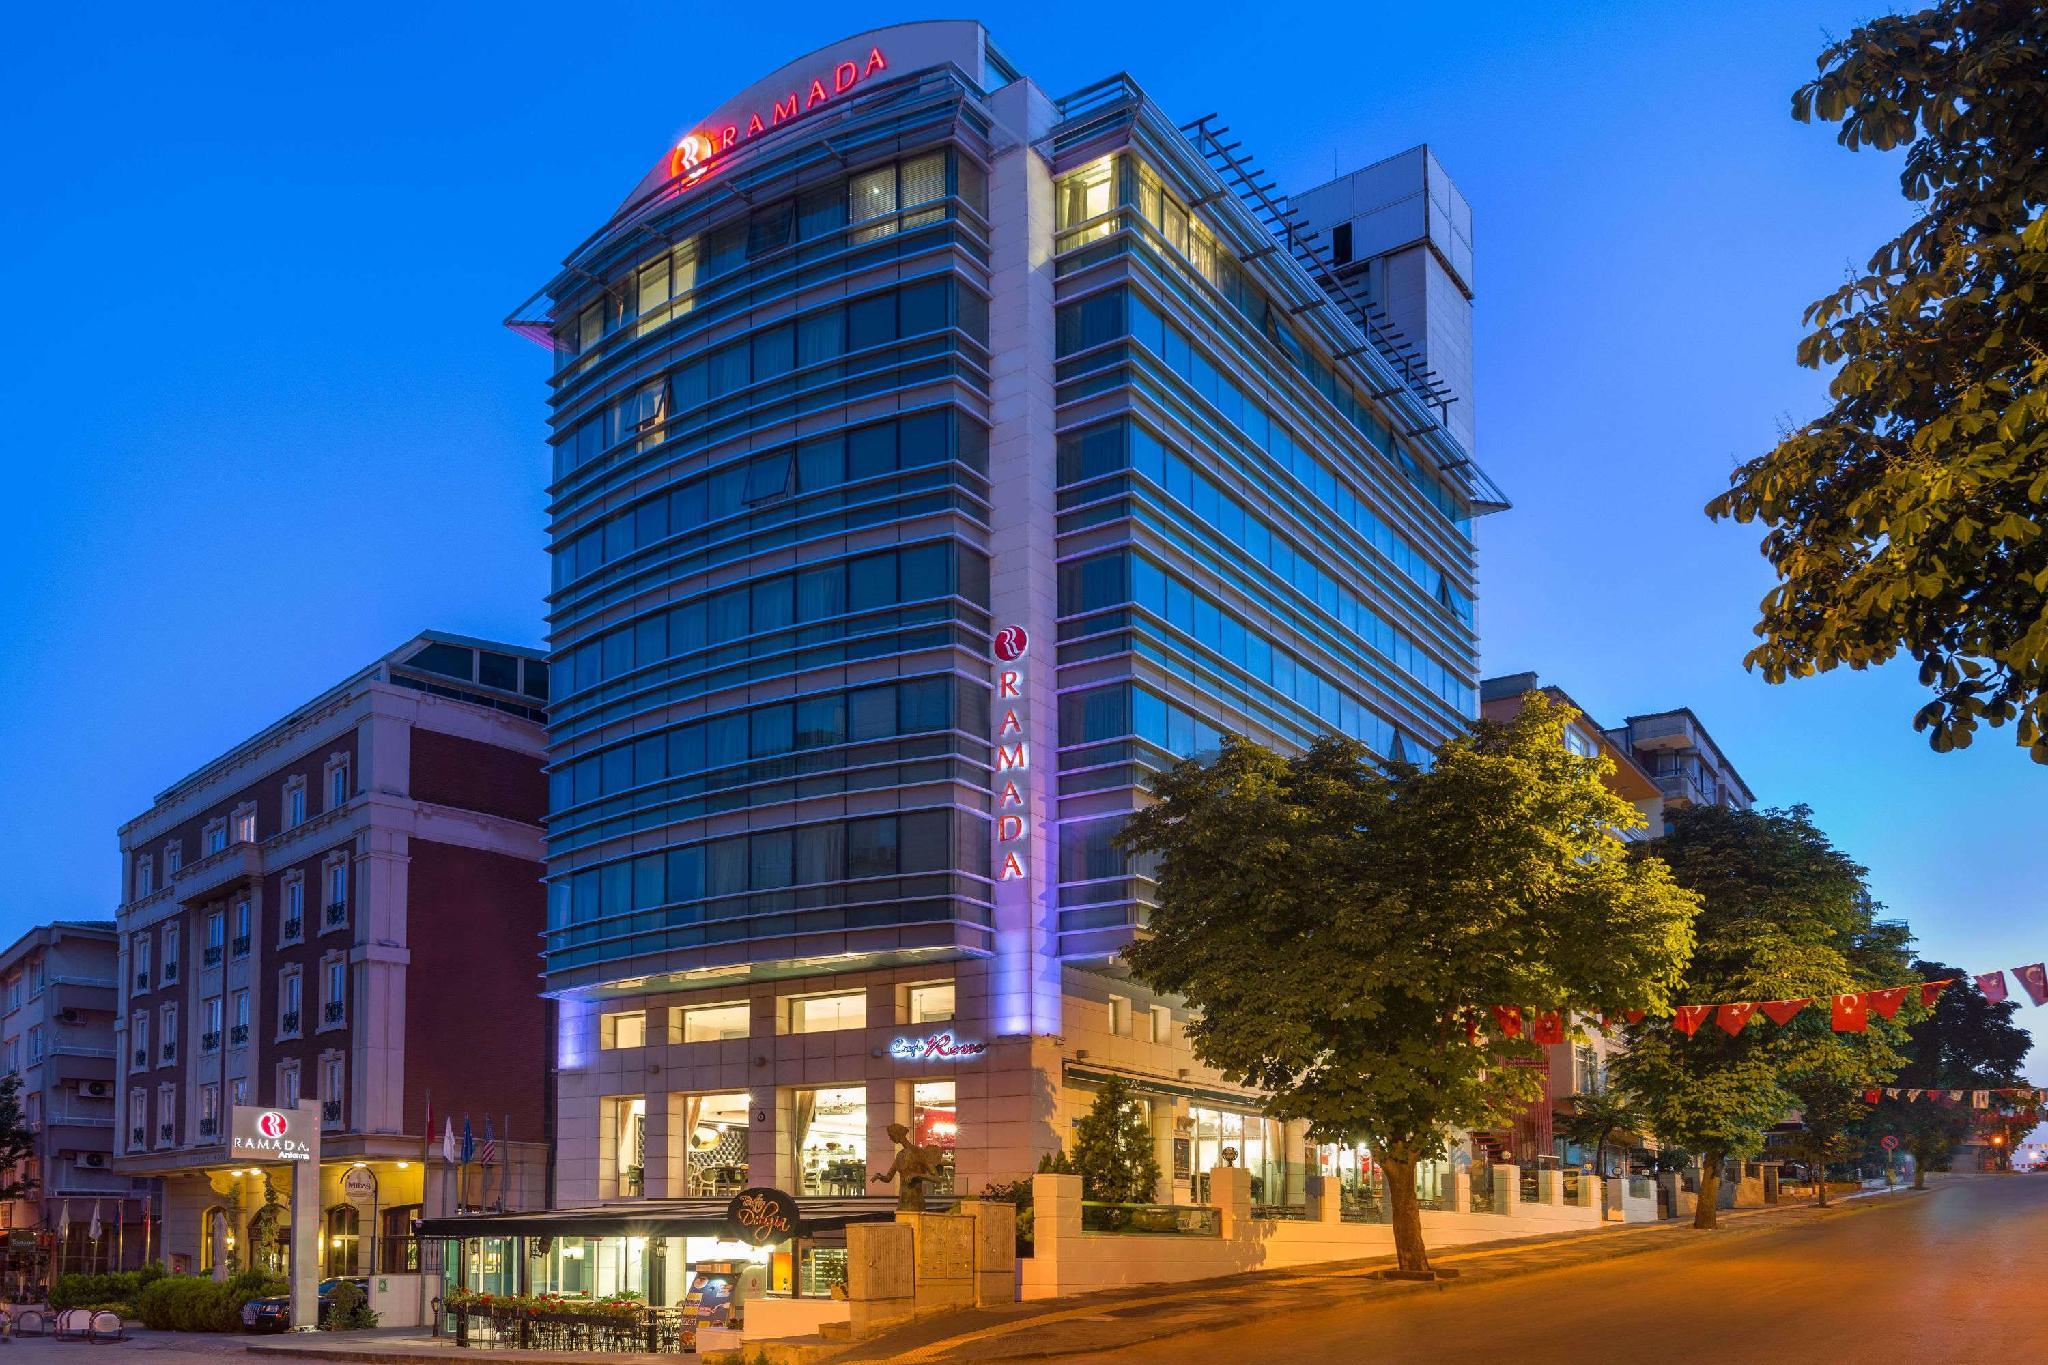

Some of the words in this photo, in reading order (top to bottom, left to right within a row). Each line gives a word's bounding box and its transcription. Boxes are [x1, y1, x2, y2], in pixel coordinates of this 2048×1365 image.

[720, 47, 887, 150] RAMADA
[995, 670, 1025, 881] RAMADA
[234, 1137, 308, 1152] RAMADA
